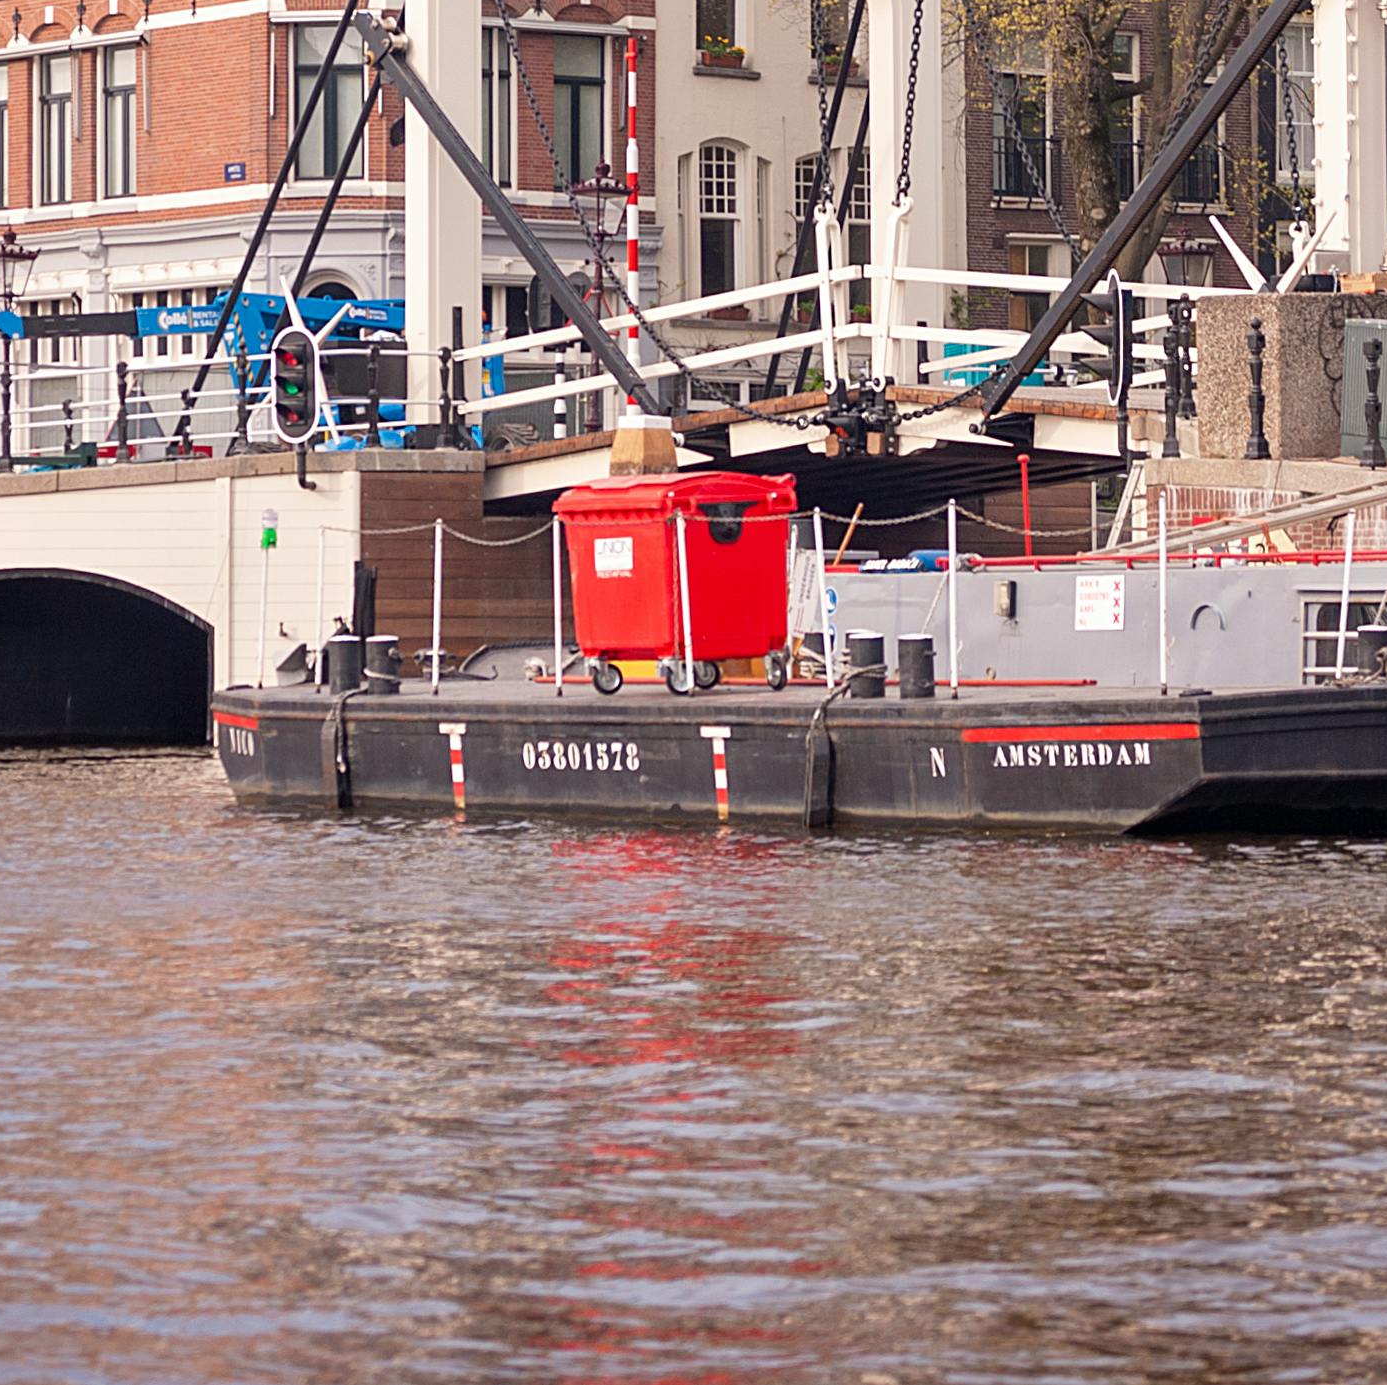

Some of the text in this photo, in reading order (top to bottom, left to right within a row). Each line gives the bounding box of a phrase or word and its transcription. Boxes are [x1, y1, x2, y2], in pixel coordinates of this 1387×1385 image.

[522, 741, 640, 771] 03801578
[930, 747, 946, 777] N
[993, 742, 1151, 767] AMSTERDAM
